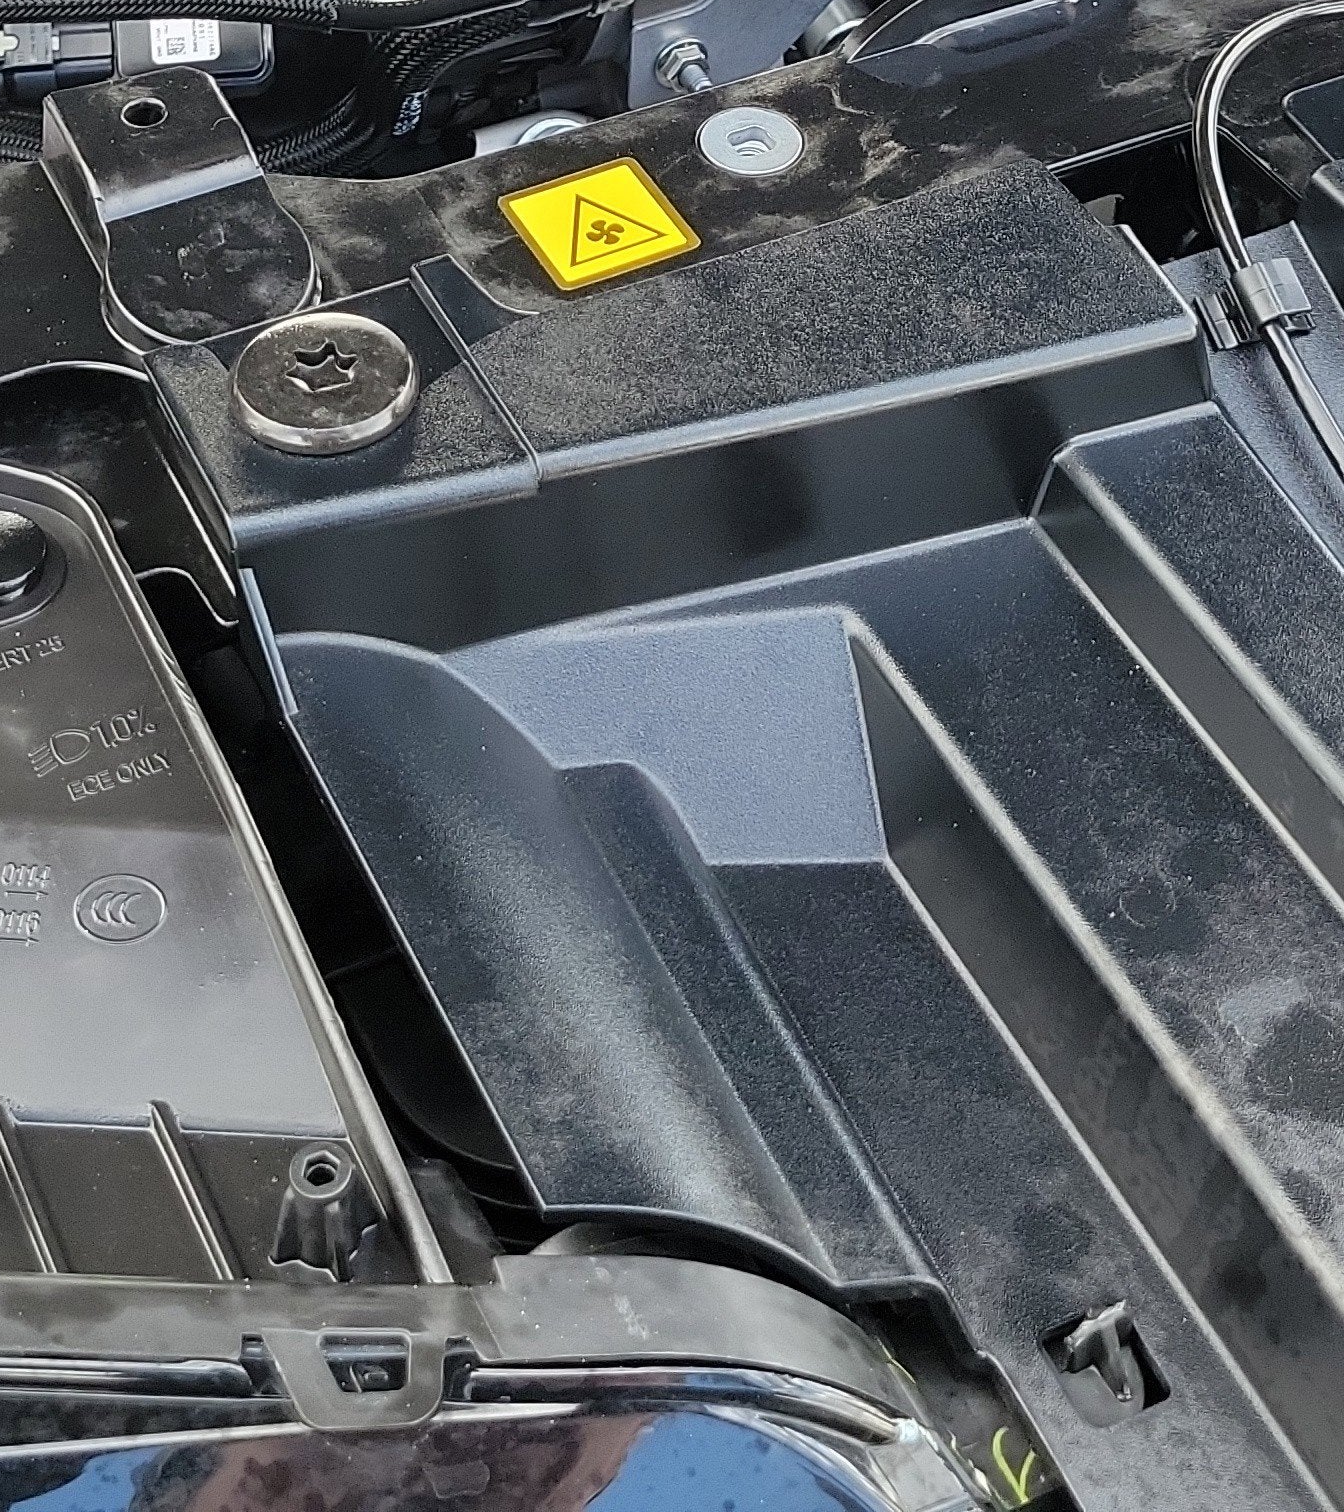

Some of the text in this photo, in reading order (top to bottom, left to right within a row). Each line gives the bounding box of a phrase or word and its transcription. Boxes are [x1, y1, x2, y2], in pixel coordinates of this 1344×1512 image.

[66, 751, 171, 802] ECE ONLY
[0, 861, 51, 889] 0114
